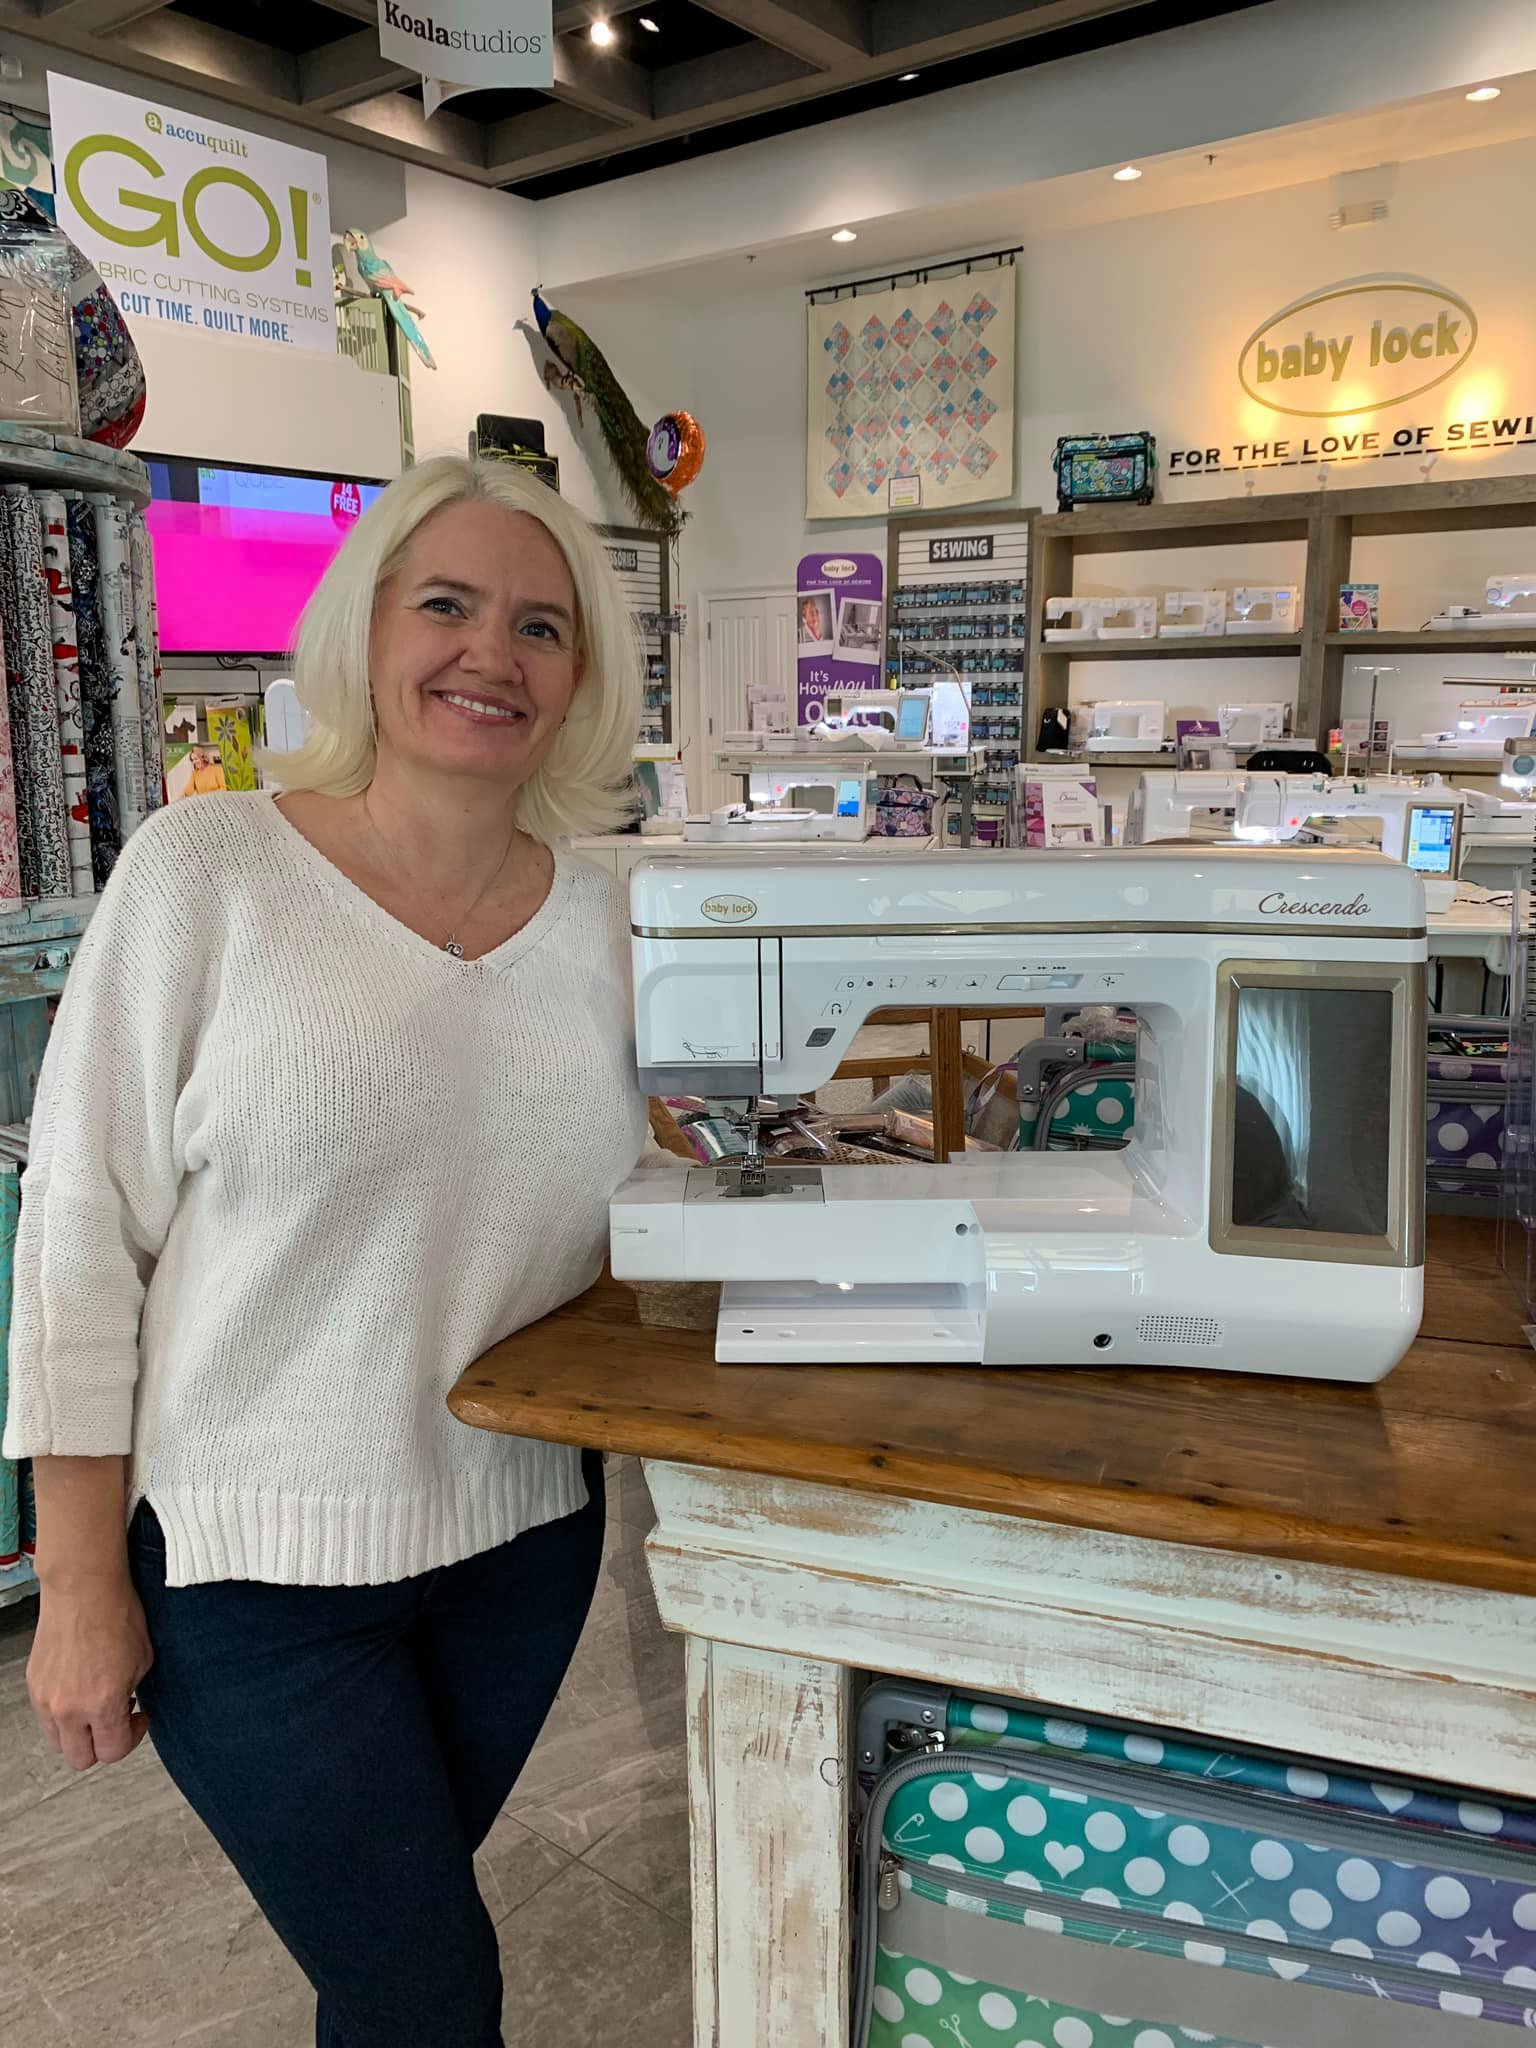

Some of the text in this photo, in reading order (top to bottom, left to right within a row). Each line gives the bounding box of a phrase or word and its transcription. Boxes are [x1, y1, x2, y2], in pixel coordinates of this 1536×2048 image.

[165, 122, 249, 158] accuquilt
[64, 134, 312, 288] GO!
[153, 273, 241, 306] CUTTING
[246, 292, 329, 323] SYSTEMS
[121, 292, 294, 344] CUT TIME. QUILT MORE.
[1257, 312, 1461, 383] baby lock
[1169, 416, 1534, 468] FOR THE LOVE OF SEWI
[334, 493, 359, 515] FREE
[933, 539, 989, 560] SEWING
[799, 681, 831, 696] How
[810, 670, 829, 682] It's
[704, 902, 753, 915] baby lock
[1258, 892, 1371, 915] Crescendo
